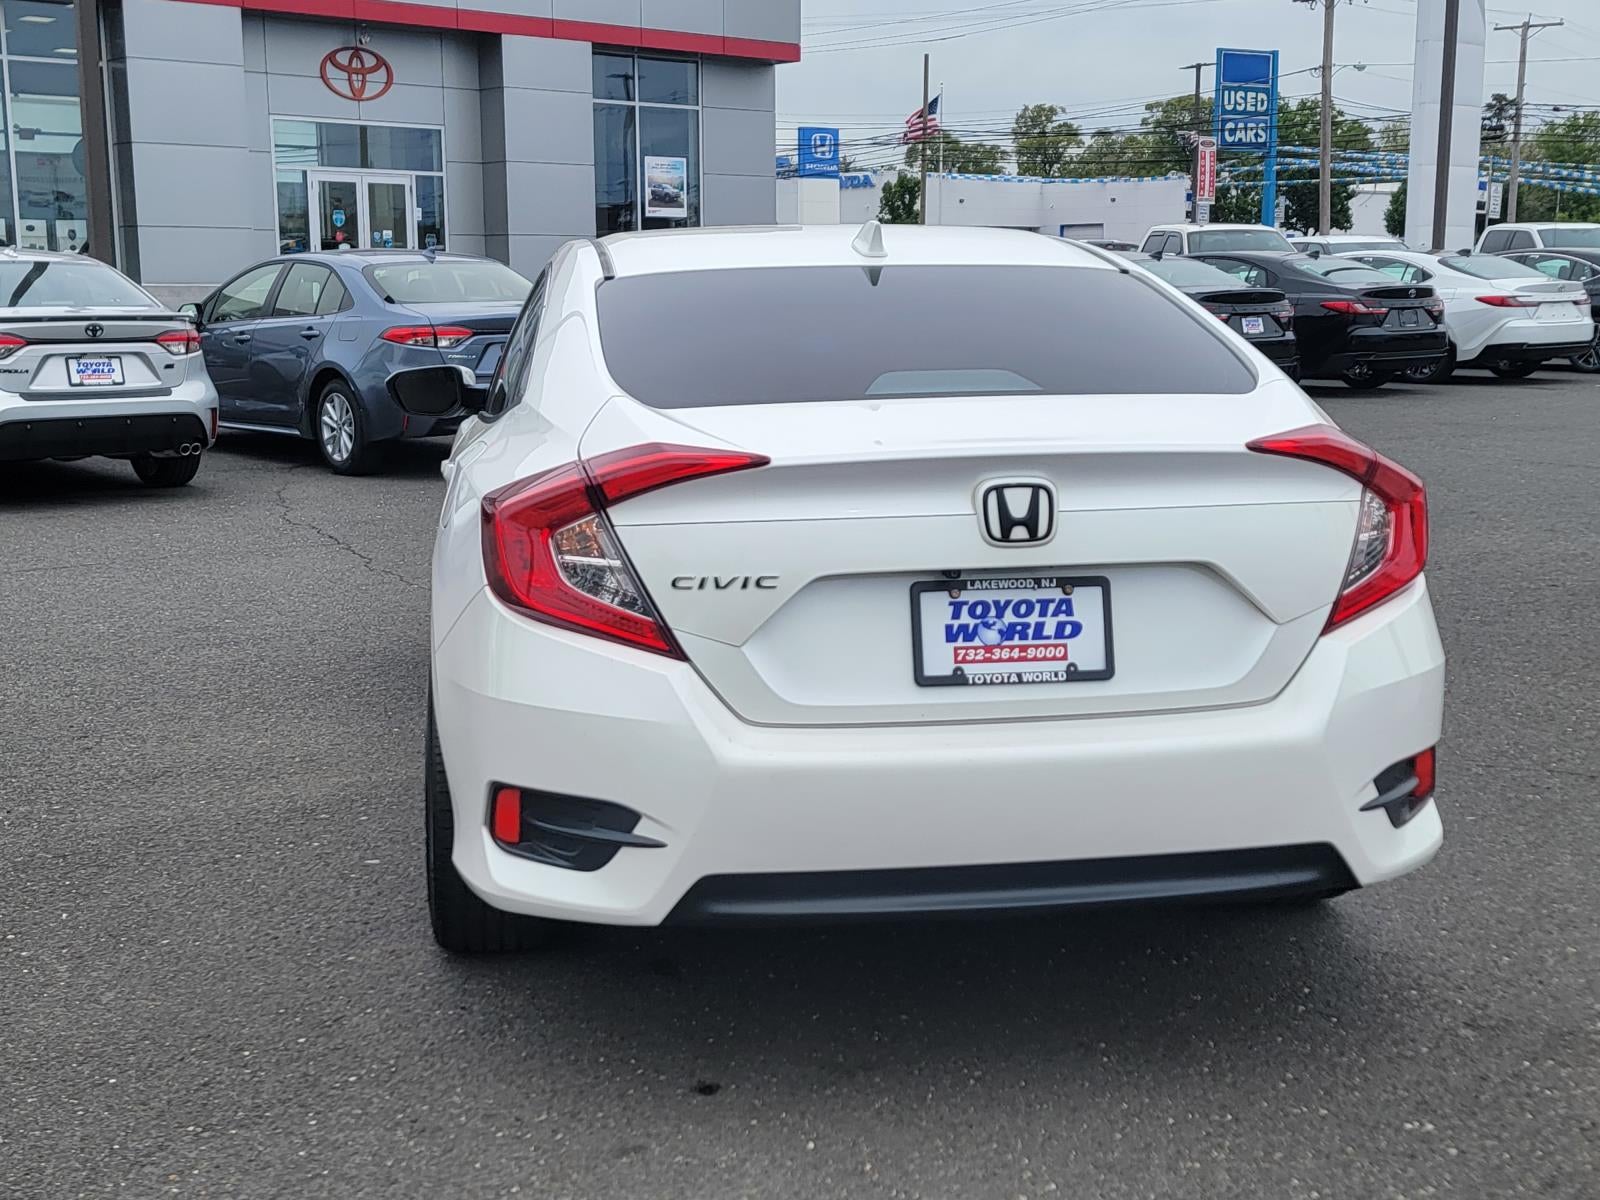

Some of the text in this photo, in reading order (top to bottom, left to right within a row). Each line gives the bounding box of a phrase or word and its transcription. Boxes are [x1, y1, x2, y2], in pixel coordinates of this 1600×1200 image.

[1223, 91, 1268, 112] USED
[1224, 122, 1267, 143] CARS
[671, 575, 780, 590] CIVIC
[967, 577, 1057, 590] LAKEWOOD, NJ
[948, 597, 1075, 620] TOYOTA
[944, 619, 1083, 645] WORLD
[956, 646, 1066, 660] 732-364-9000
[967, 671, 1067, 685] TOYOTA WORLD
